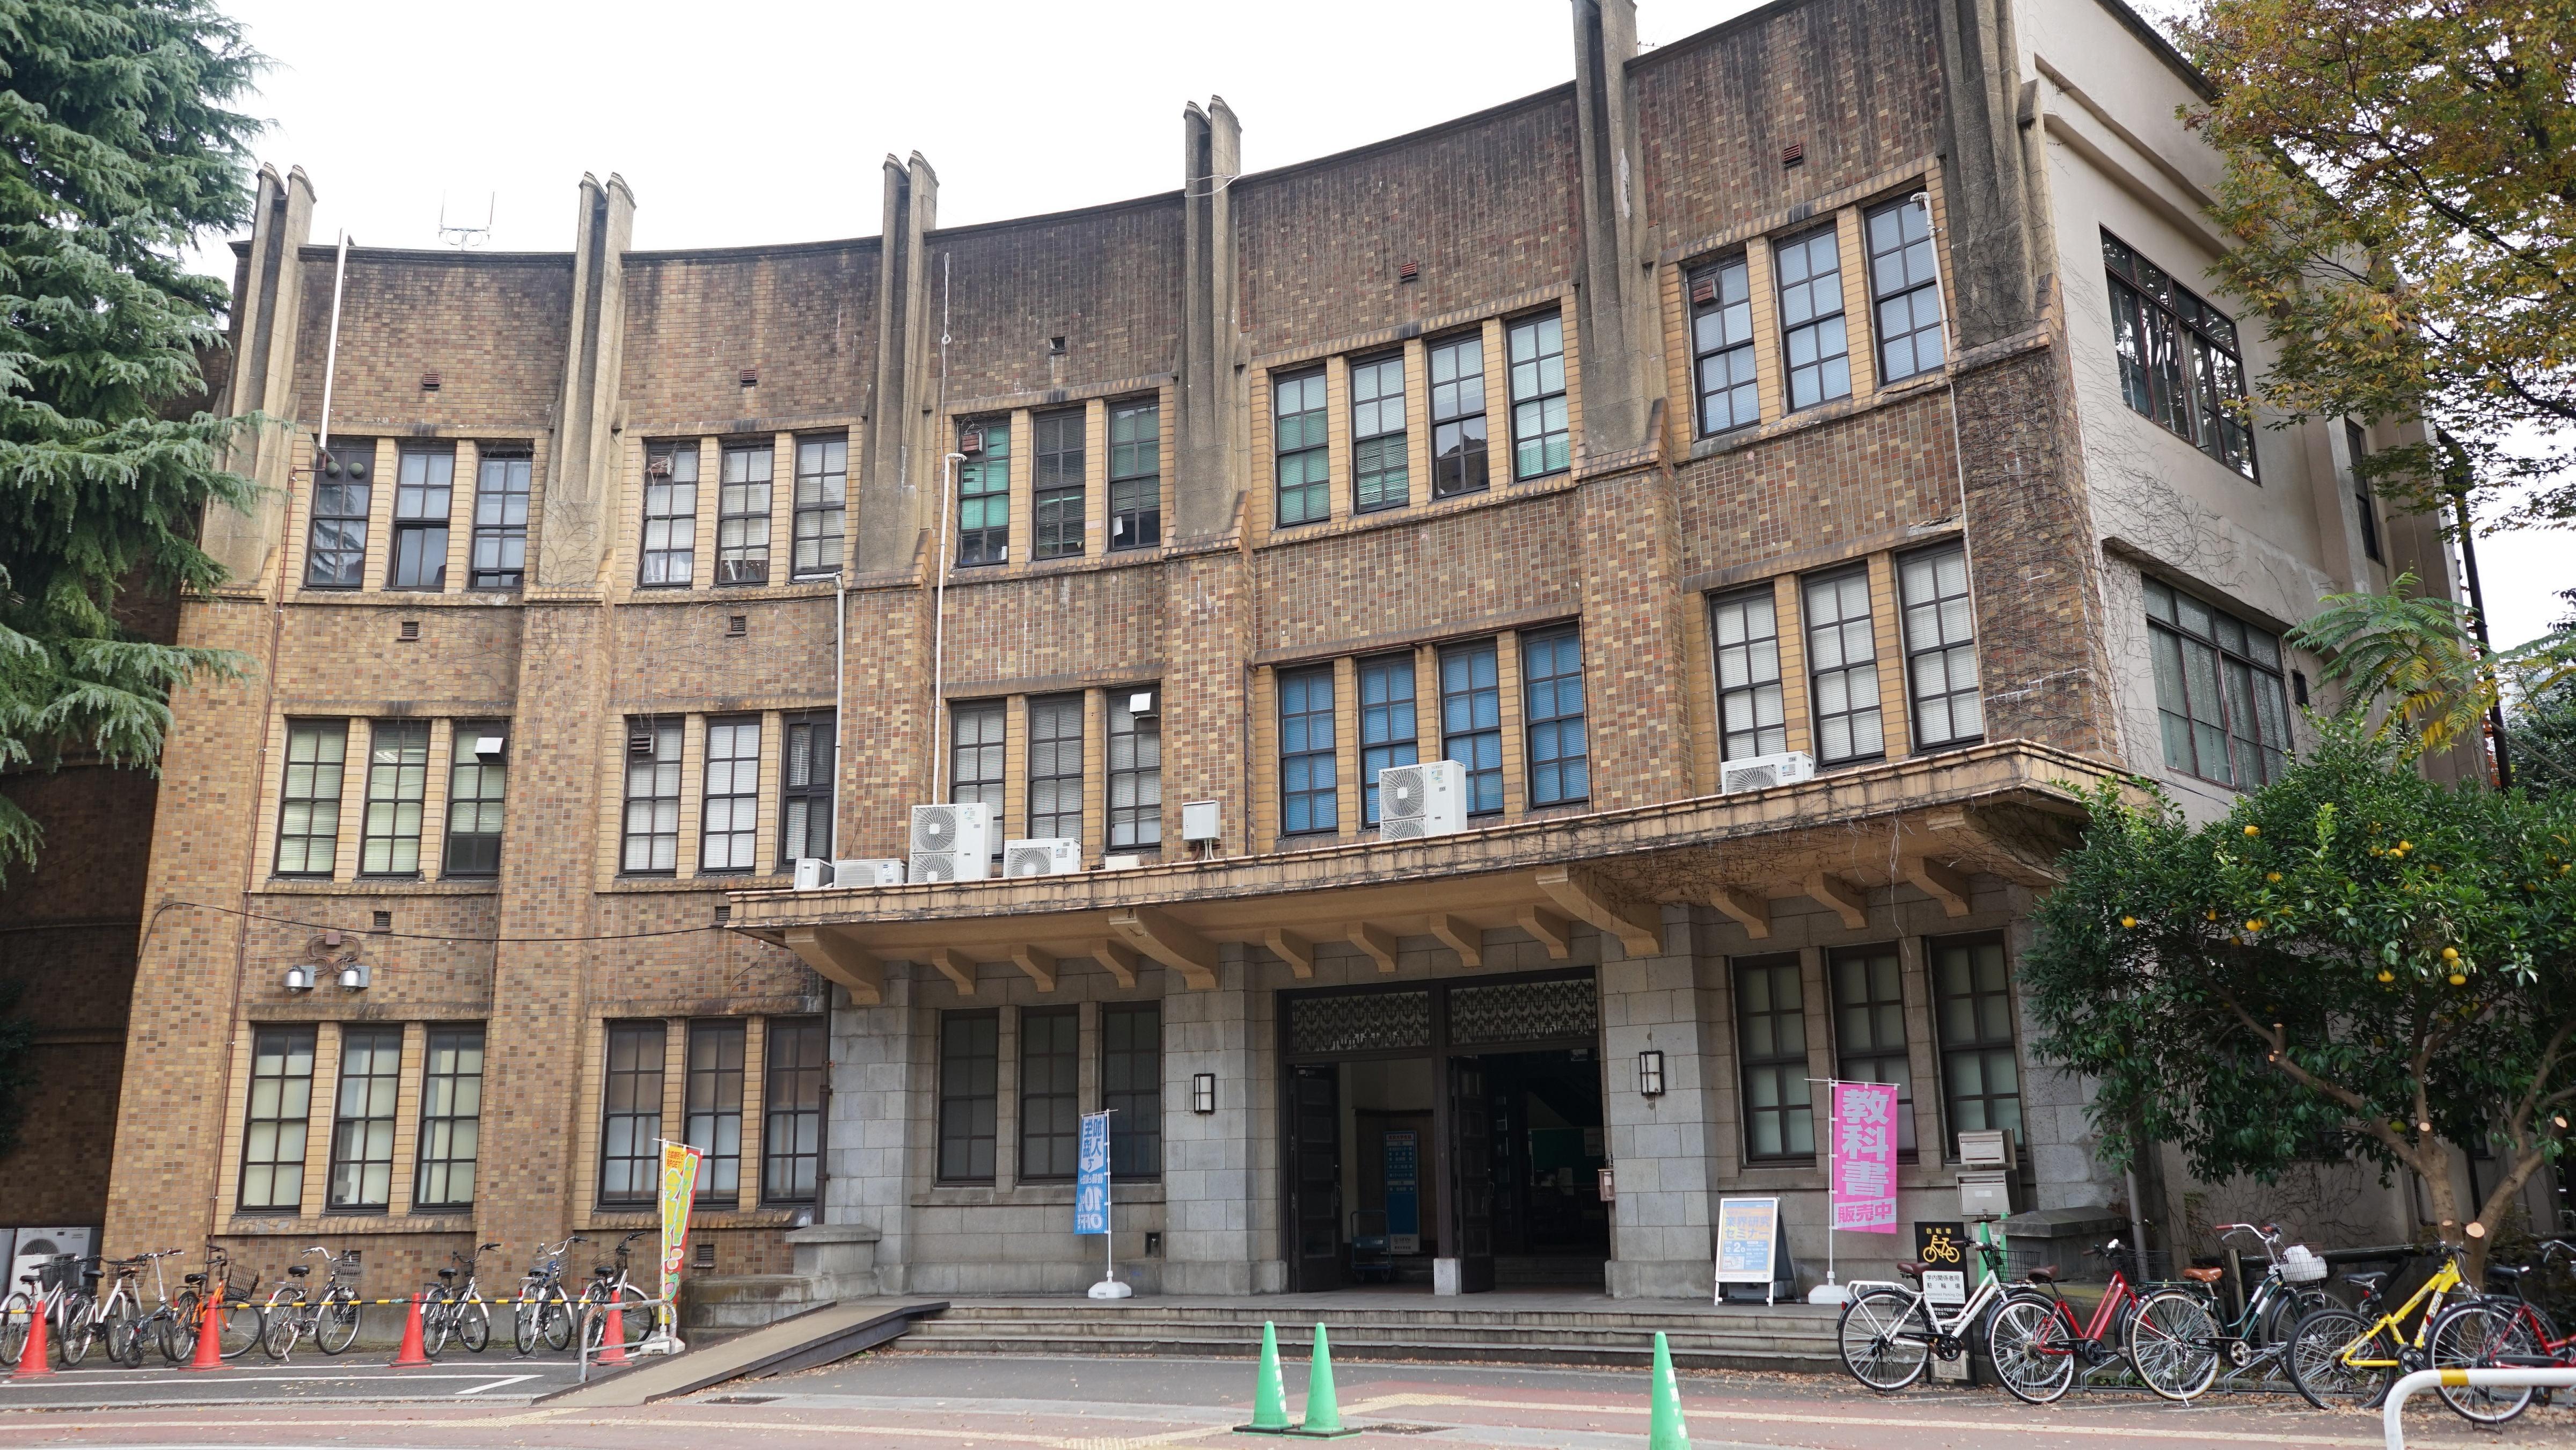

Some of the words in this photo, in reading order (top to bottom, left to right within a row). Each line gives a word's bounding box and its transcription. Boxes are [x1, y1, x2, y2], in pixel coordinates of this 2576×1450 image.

[1842, 1089, 1889, 1197] 教科書
[1838, 1202, 1892, 1223] 販売中
[1725, 1216, 1770, 1227] 業界研究
[1725, 1228, 1769, 1238] セミナー
[1733, 1242, 1741, 1252] 2
